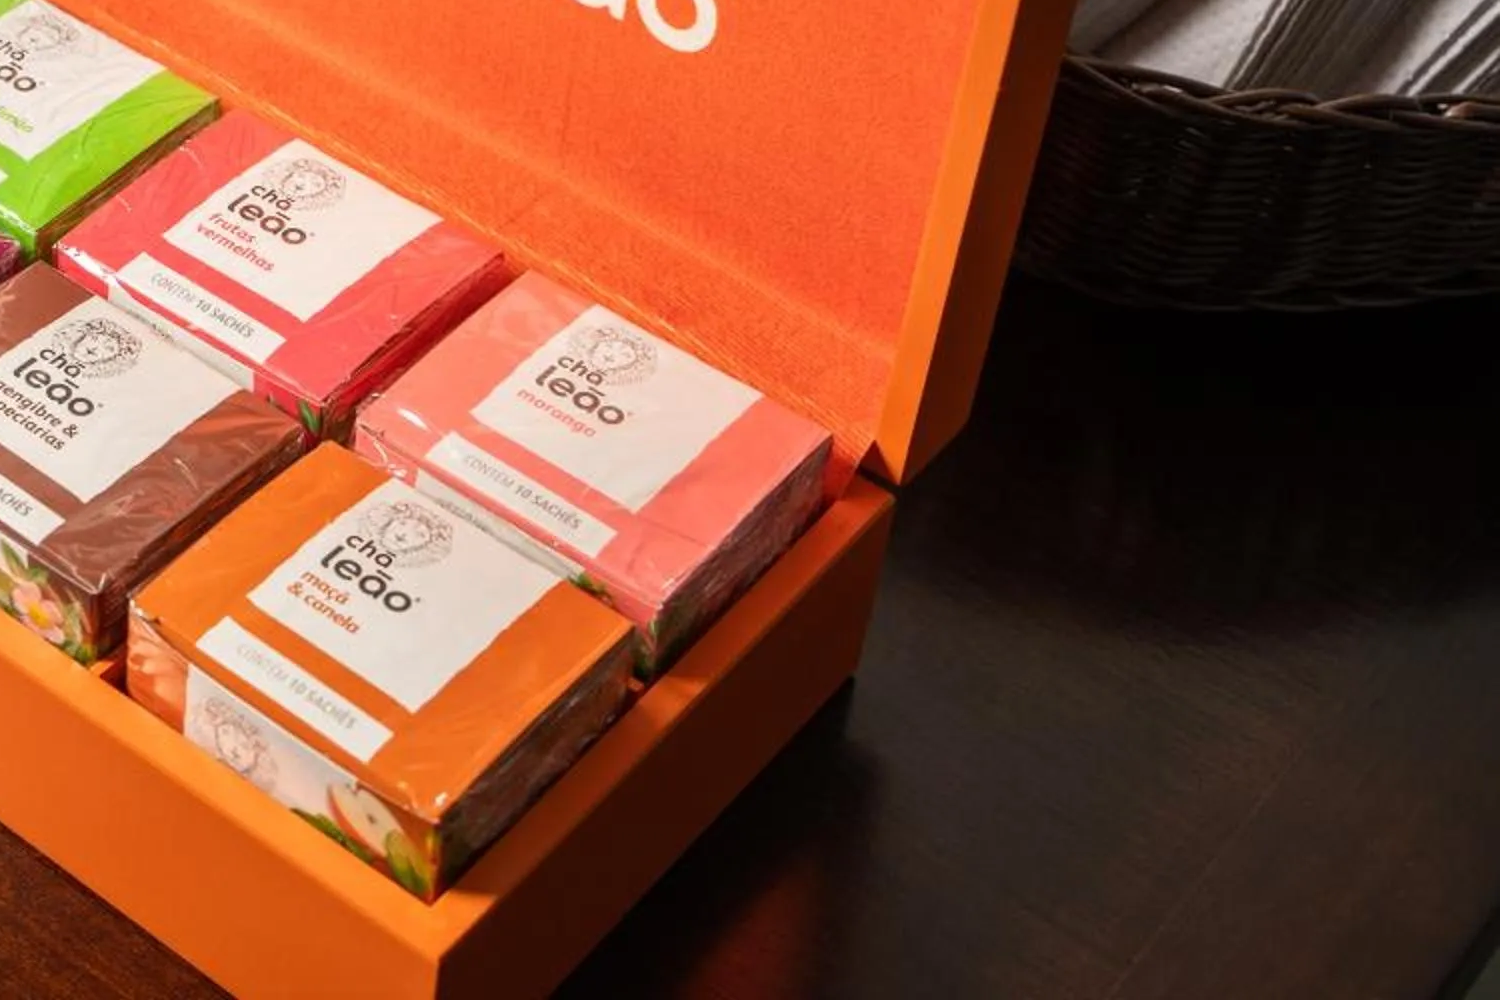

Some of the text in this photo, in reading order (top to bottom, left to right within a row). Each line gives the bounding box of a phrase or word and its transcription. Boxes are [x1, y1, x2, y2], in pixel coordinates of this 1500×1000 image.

[208, 213, 257, 244] frutas
[197, 222, 275, 272] vermelhas
[195, 298, 213, 313] 10
[516, 389, 597, 437] morango
[62, 423, 80, 440] &
[514, 484, 533, 500] 10
[287, 581, 361, 634] & canela
